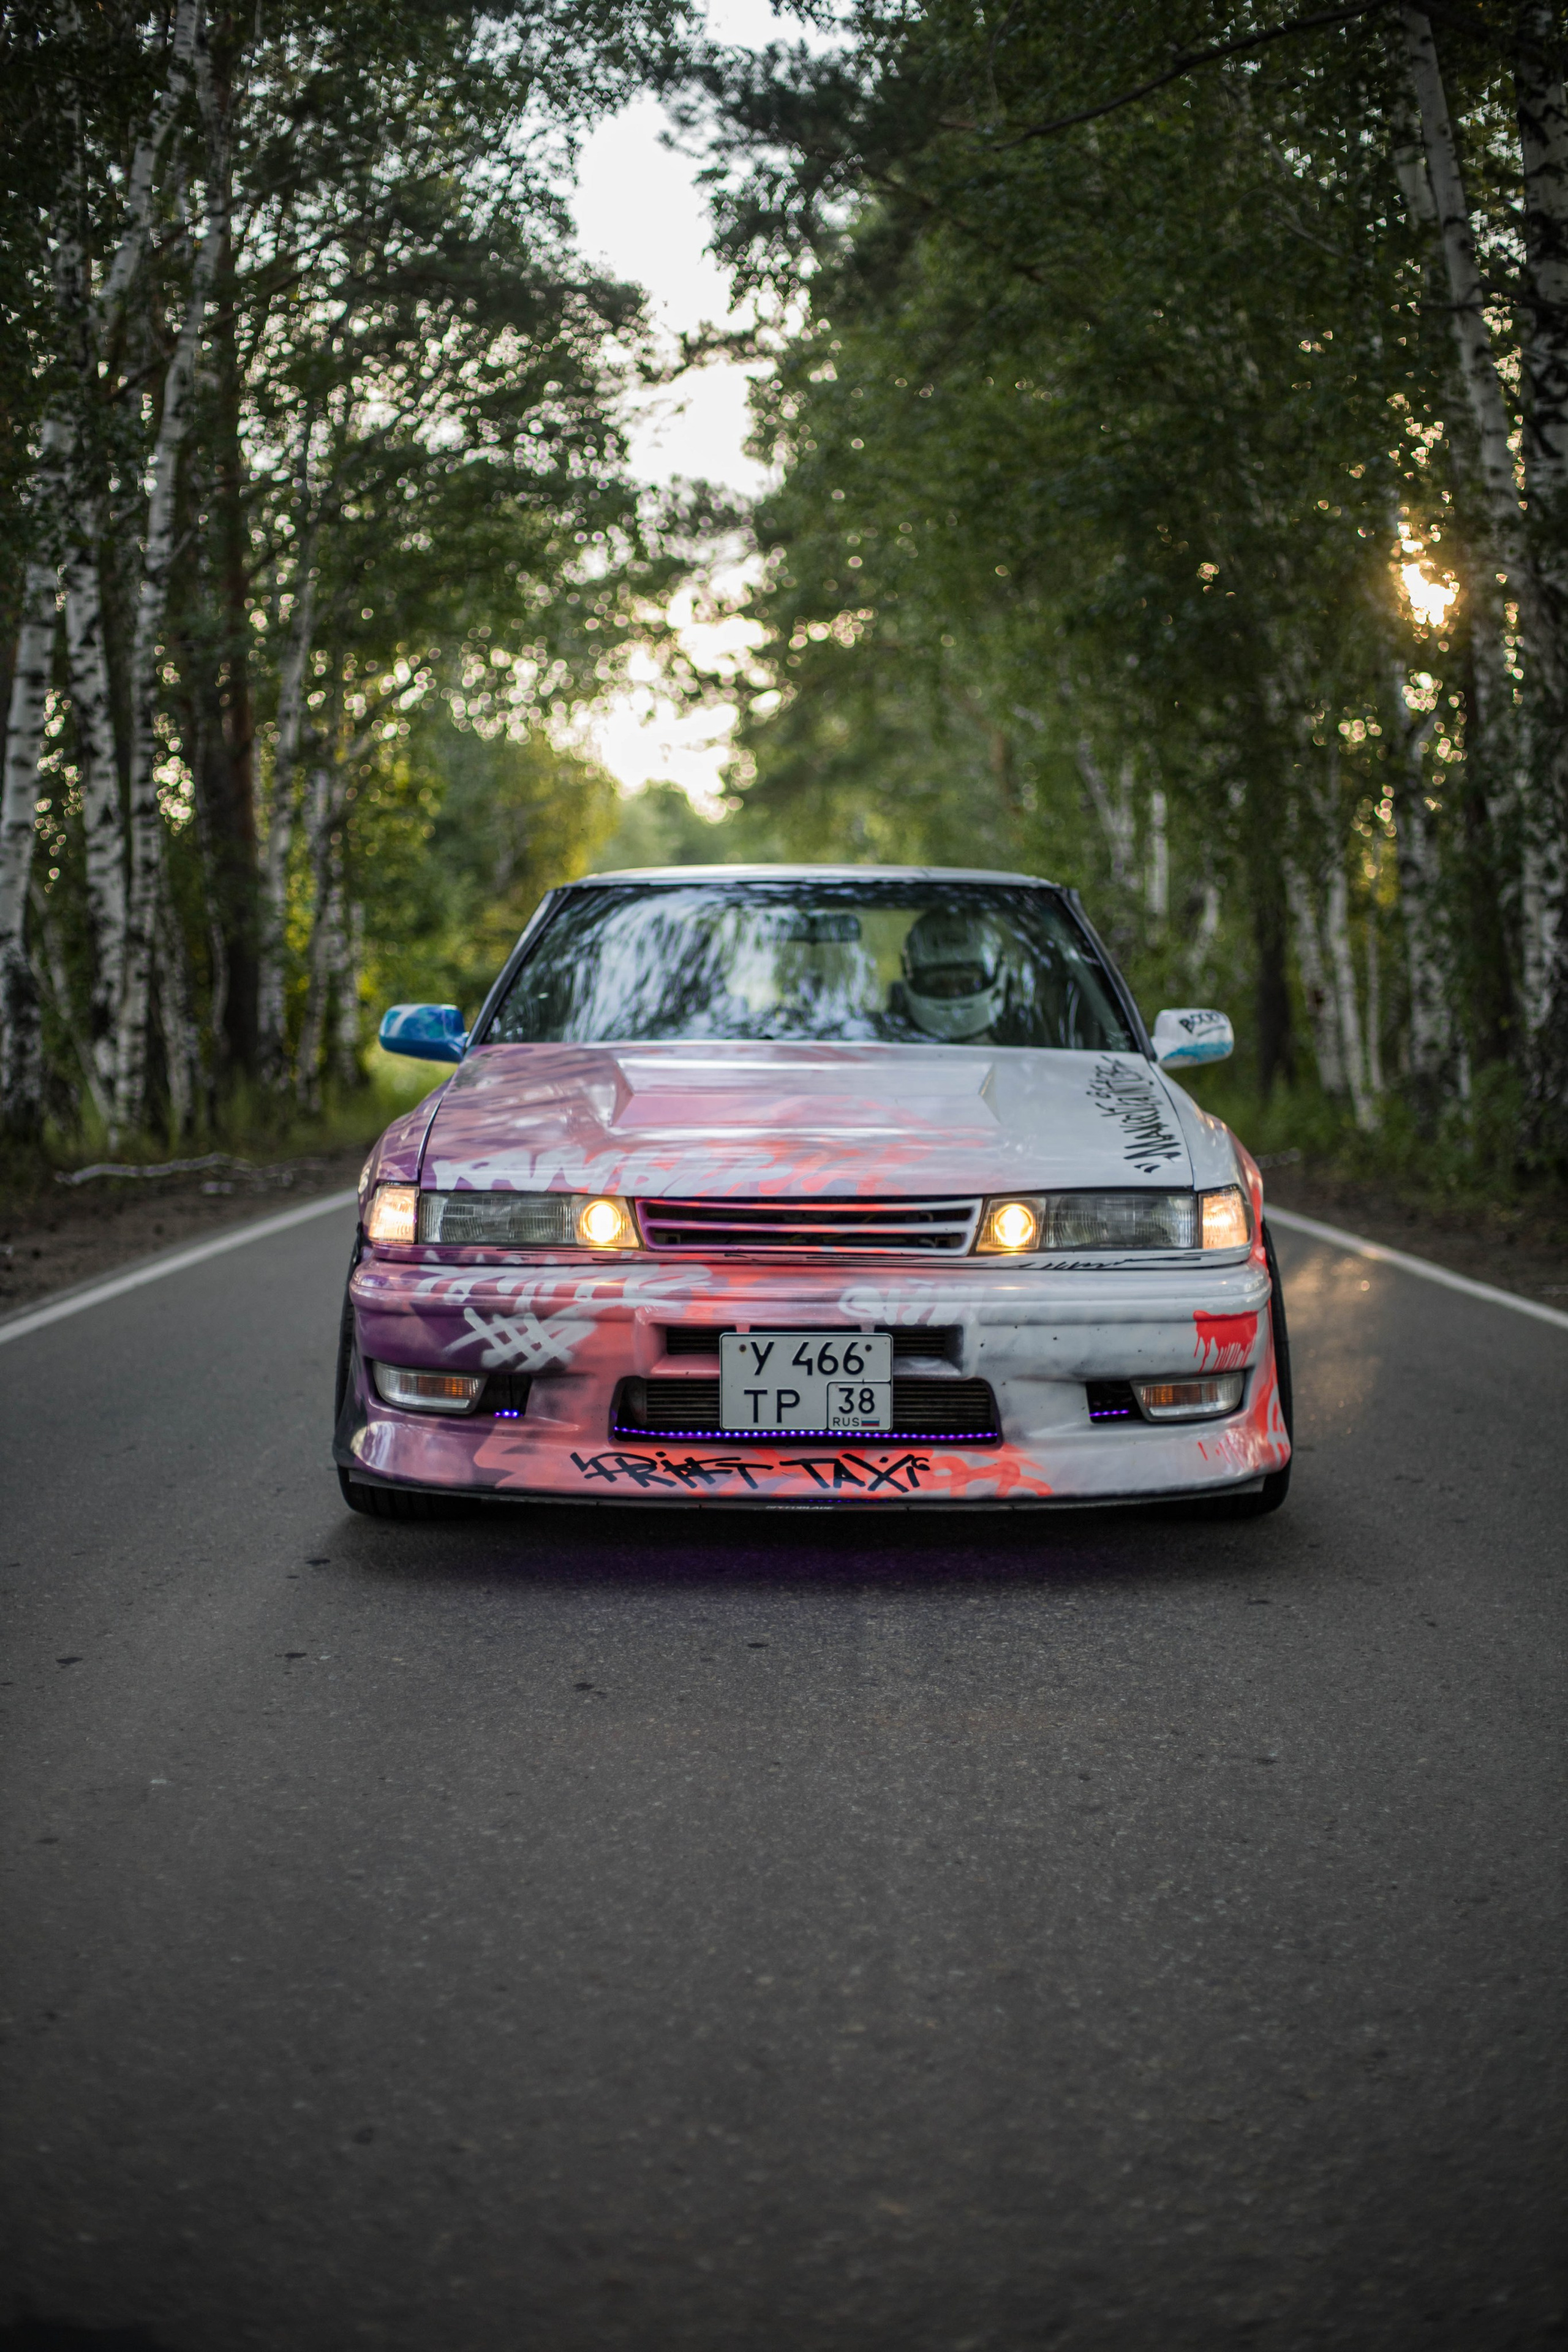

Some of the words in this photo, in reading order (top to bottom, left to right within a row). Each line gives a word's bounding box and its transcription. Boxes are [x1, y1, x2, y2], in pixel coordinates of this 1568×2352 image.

[792, 1341, 864, 1376] 466
[839, 1387, 875, 1414] 38
[833, 1417, 859, 1427] RUS
